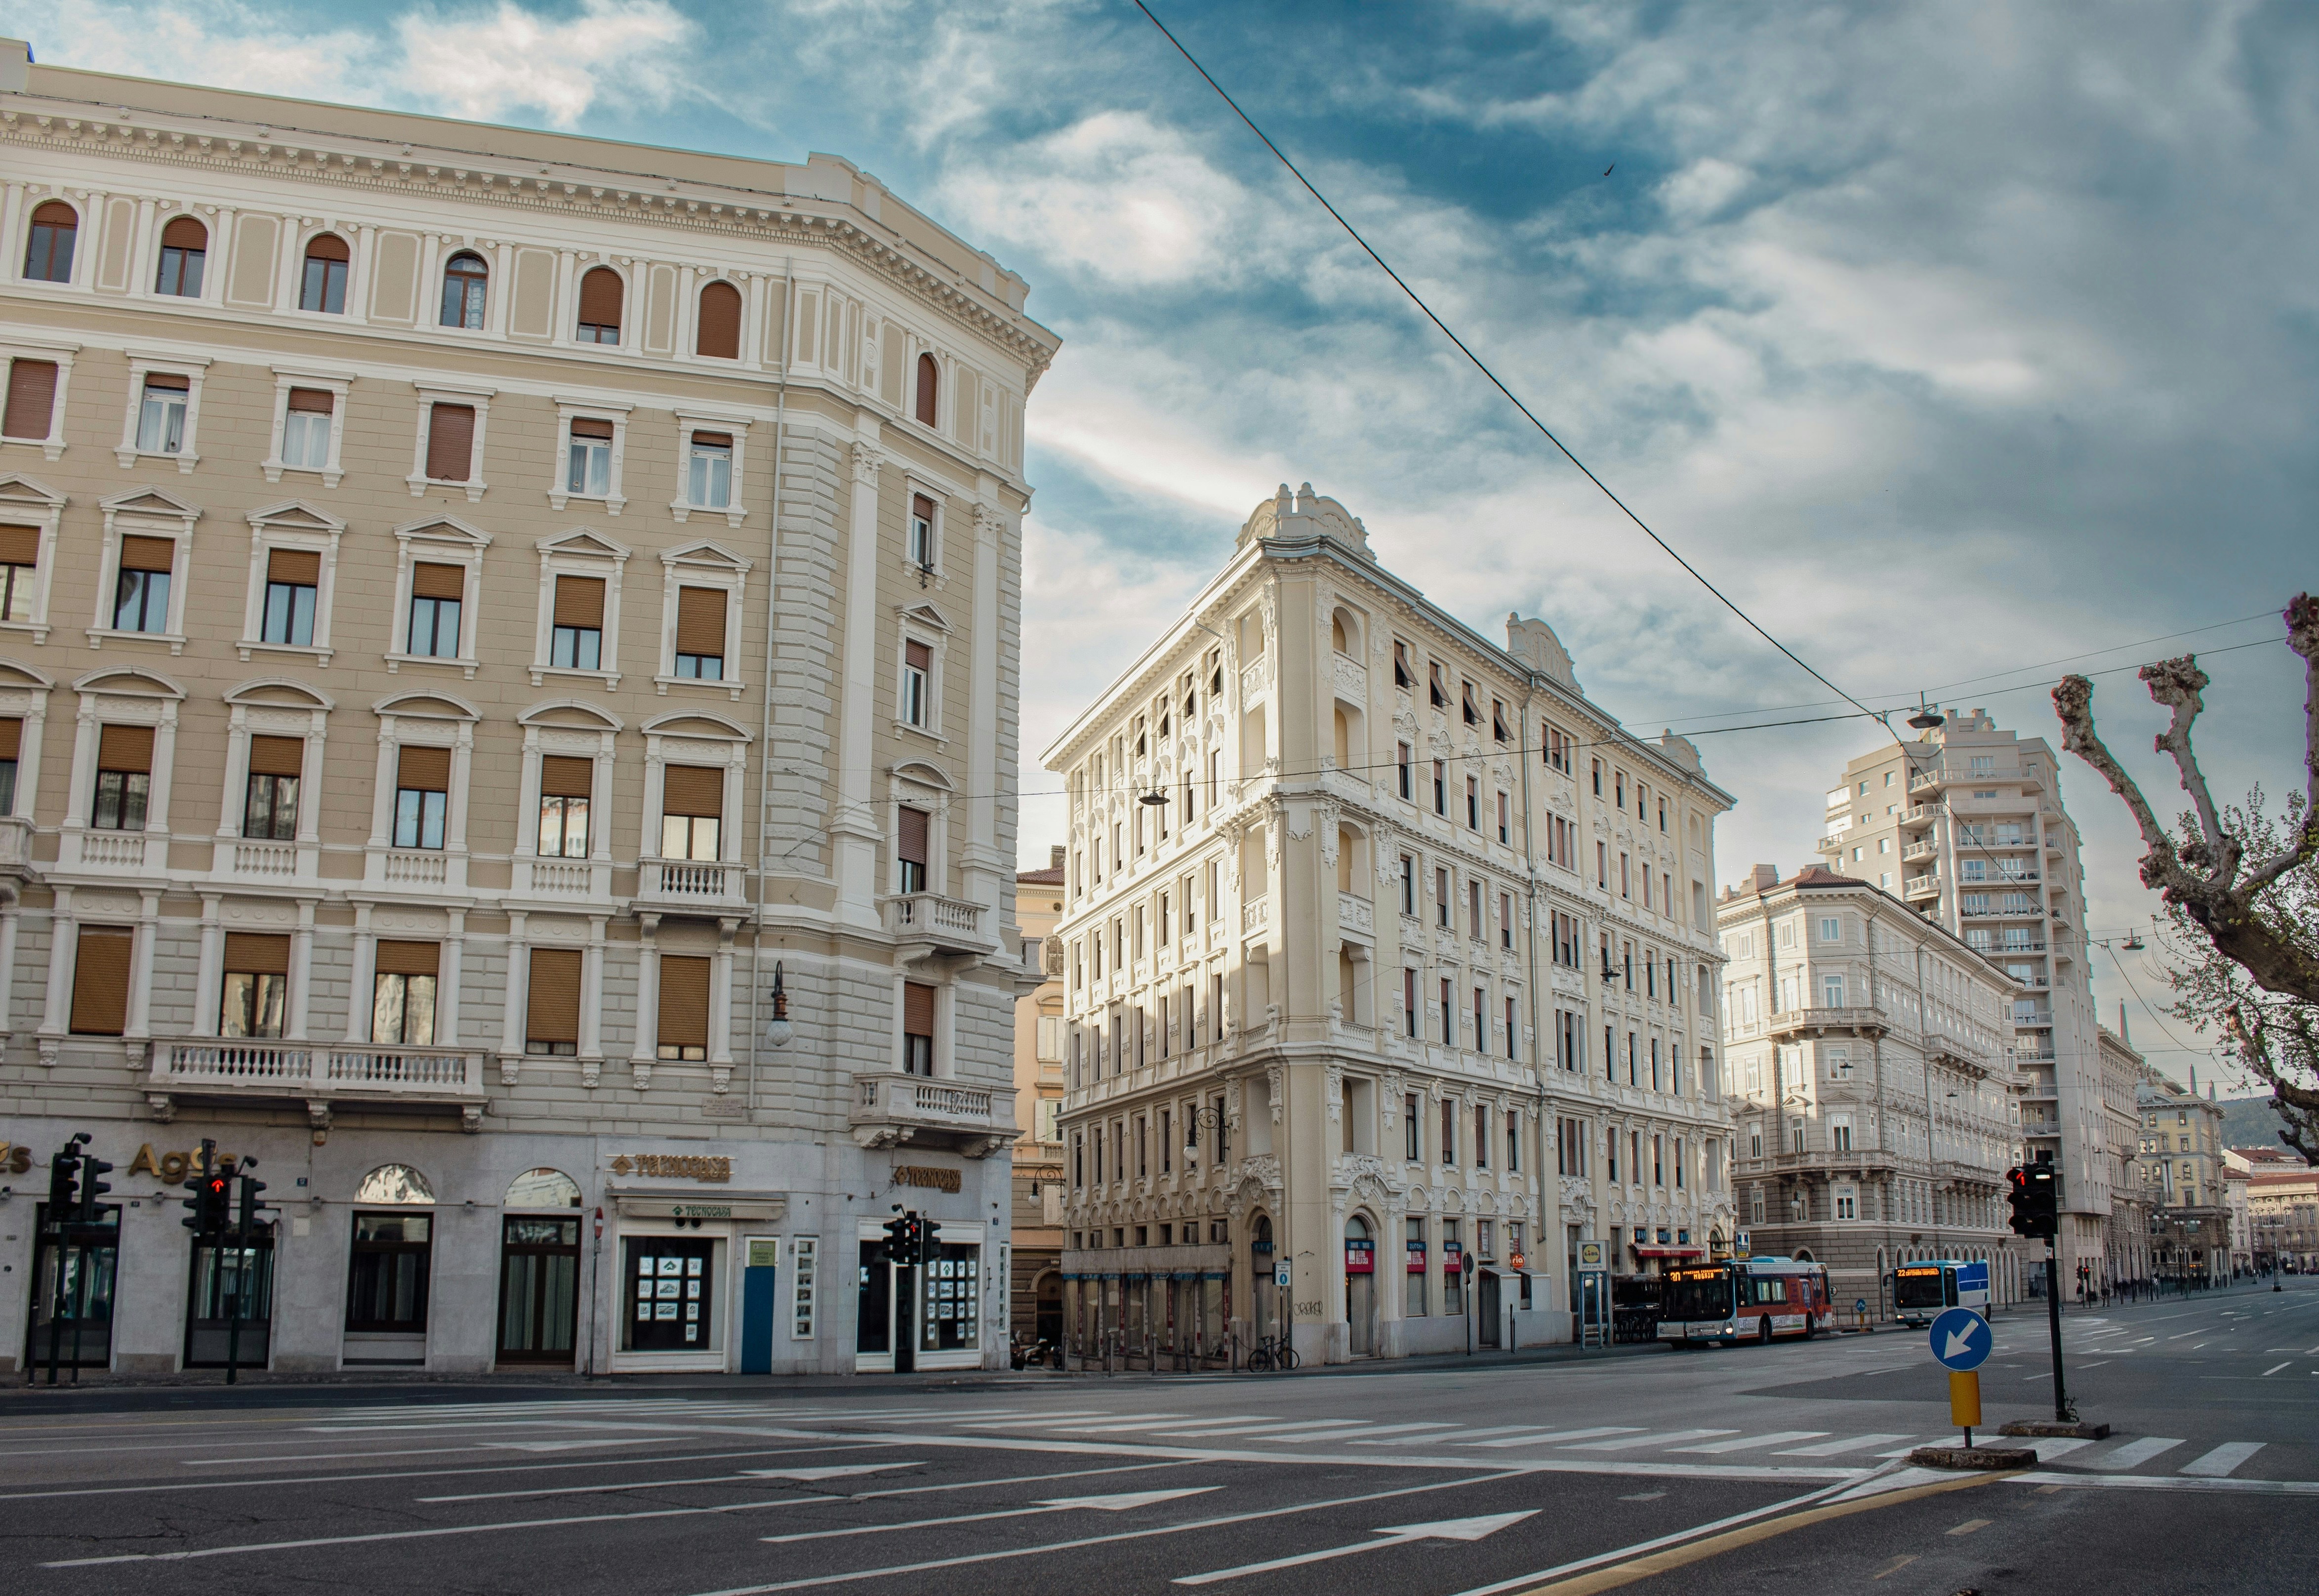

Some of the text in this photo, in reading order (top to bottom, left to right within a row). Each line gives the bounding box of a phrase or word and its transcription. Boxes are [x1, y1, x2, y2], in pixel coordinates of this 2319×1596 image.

[635, 1154, 730, 1179] TECNOCASA
[908, 1166, 962, 1189] TECNOCASA
[685, 1206, 731, 1217] TECNOCASA
[1512, 1255, 1523, 1264] ria
